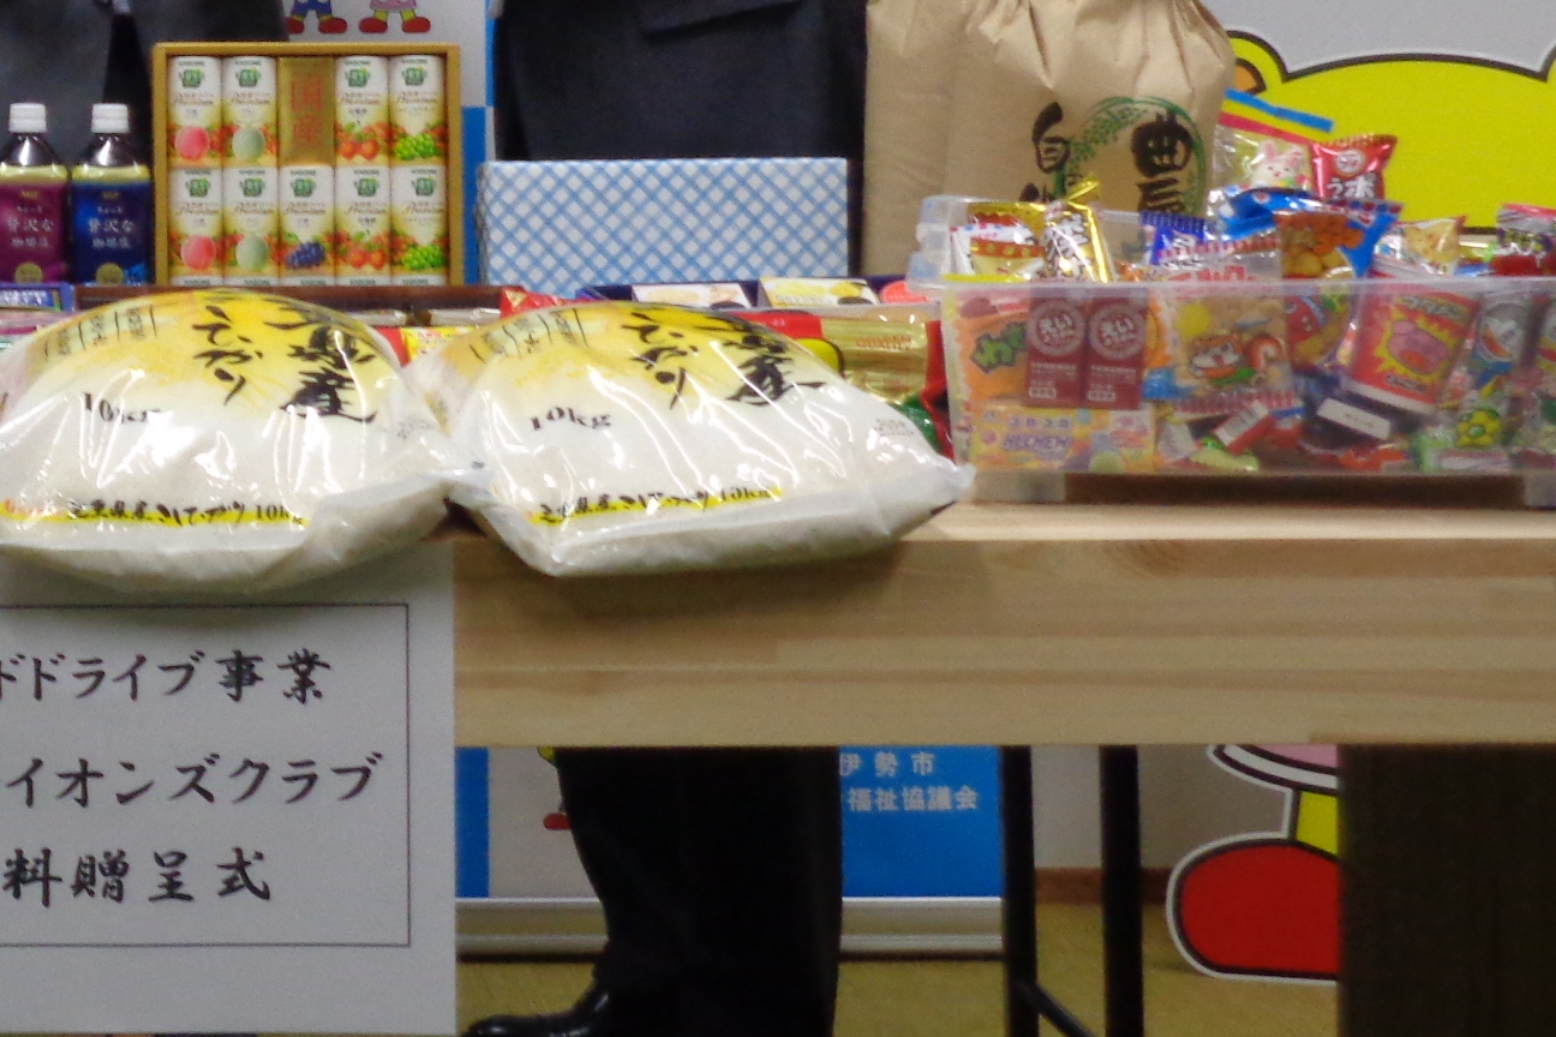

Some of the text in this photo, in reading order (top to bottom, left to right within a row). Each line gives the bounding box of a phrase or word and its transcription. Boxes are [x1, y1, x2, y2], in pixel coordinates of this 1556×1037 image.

[531, 405, 611, 430] 10kg
[848, 786, 978, 812] 福祉協議会
